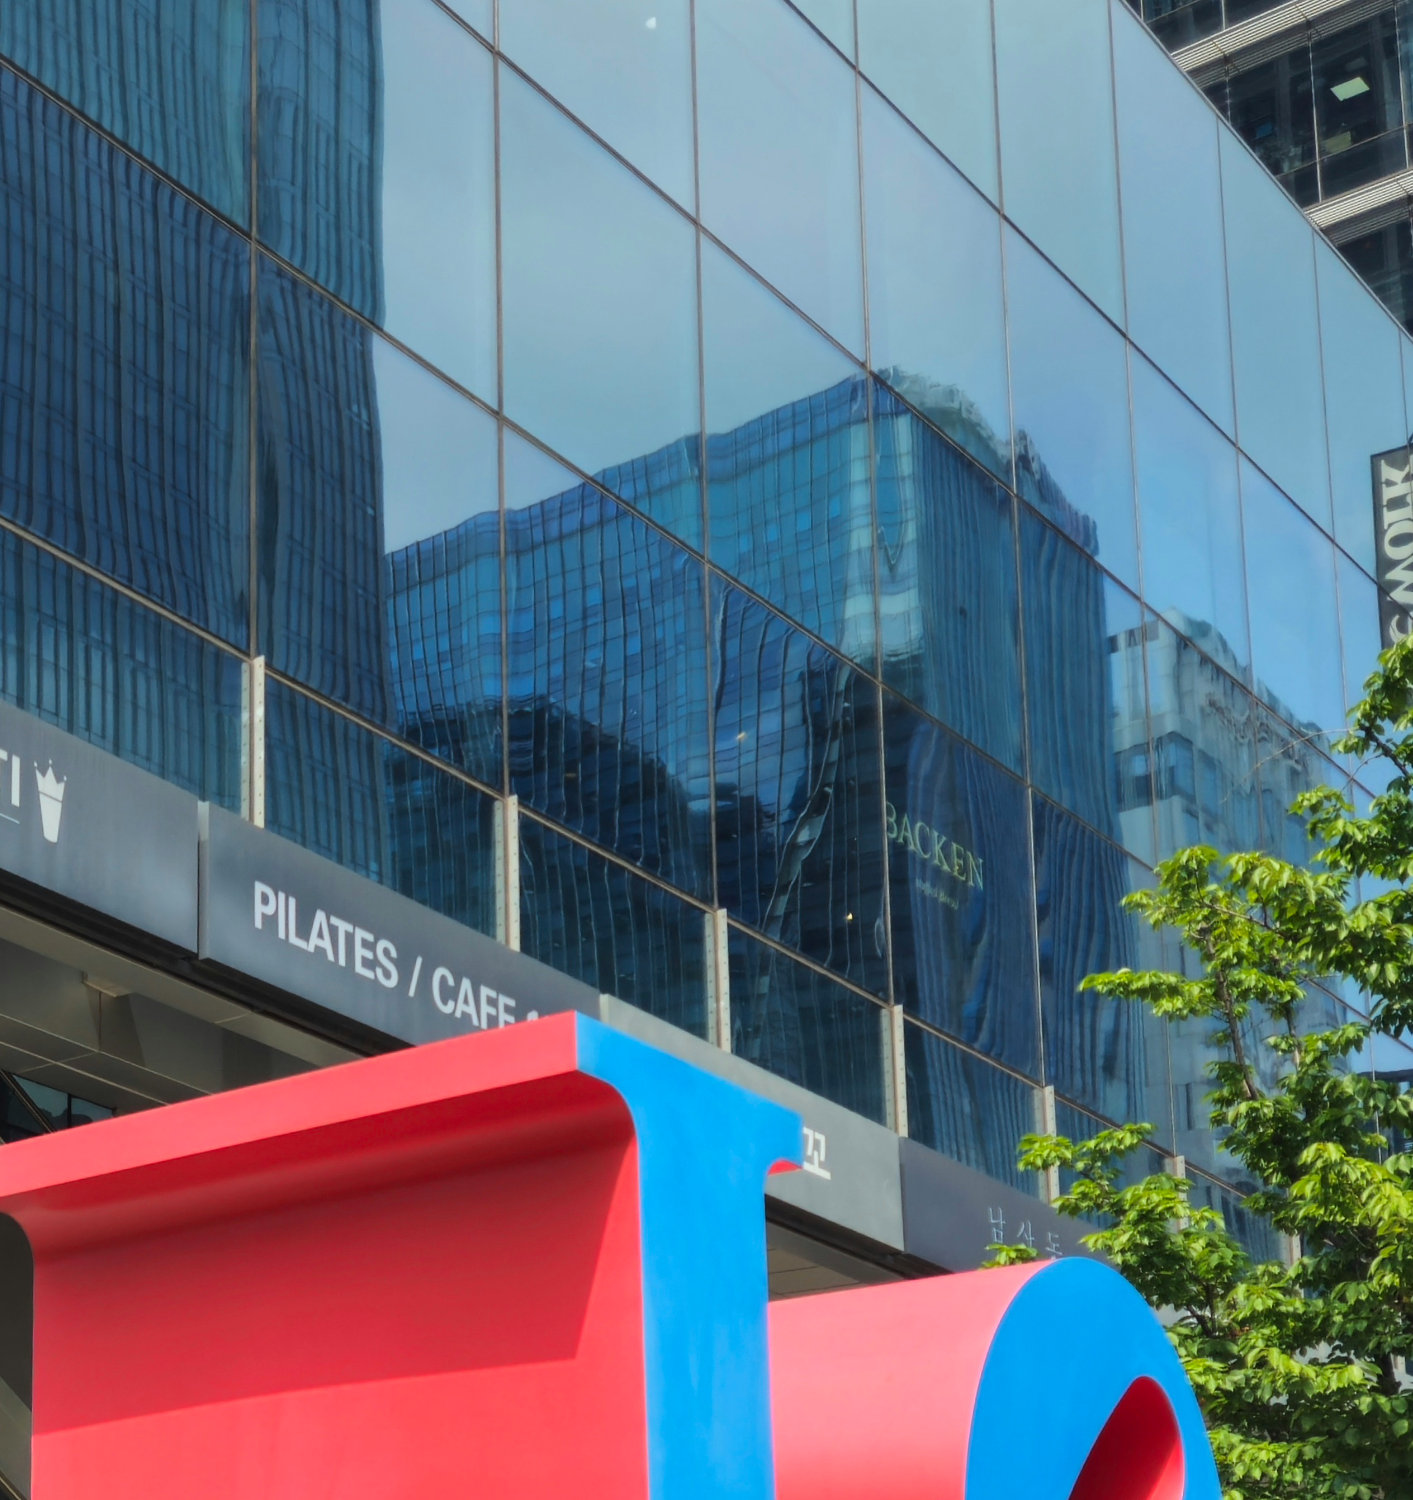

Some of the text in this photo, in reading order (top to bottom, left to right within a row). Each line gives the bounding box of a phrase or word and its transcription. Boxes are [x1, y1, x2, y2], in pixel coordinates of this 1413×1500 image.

[886, 801, 983, 892] BACKEN
[254, 880, 399, 988] PILATES
[432, 966, 516, 1028] CAFE
